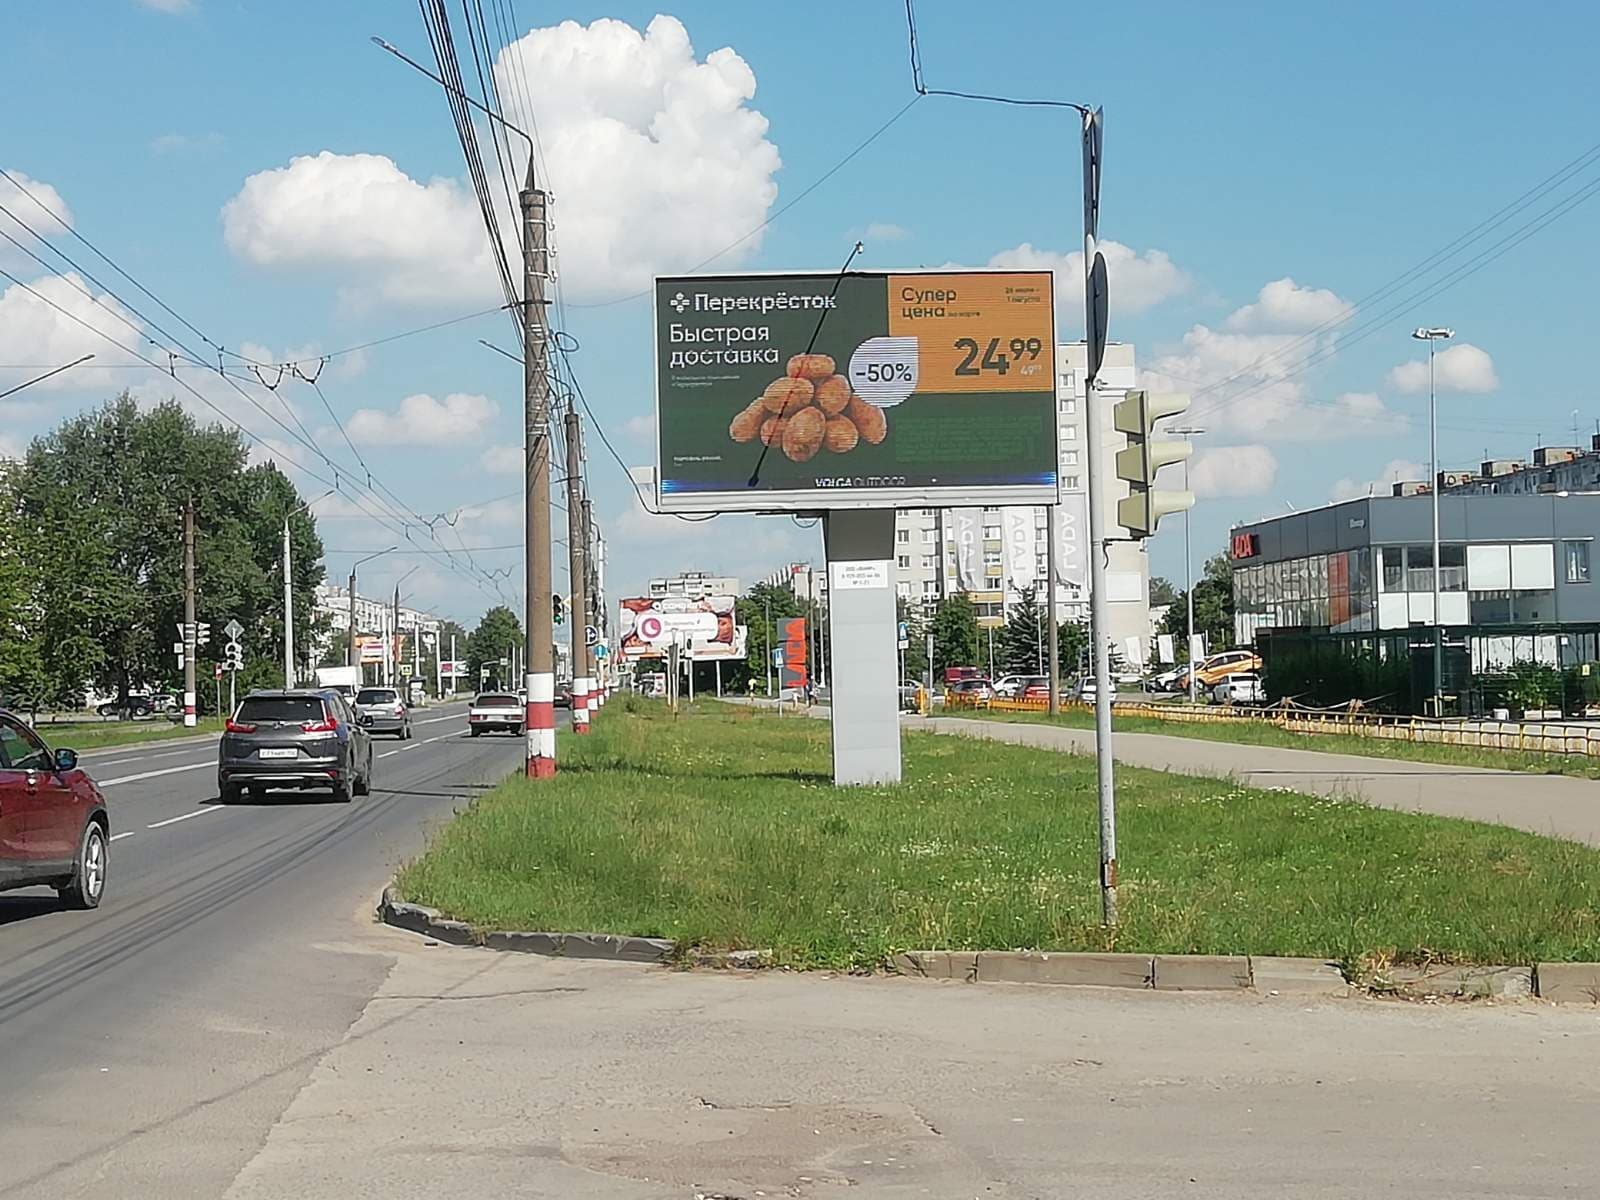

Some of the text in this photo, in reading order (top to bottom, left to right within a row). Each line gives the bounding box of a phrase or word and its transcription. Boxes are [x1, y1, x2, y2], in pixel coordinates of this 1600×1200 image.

[695, 292, 837, 314] Перекрёсток
[902, 287, 957, 304] Супер
[902, 305, 945, 320] цена
[670, 324, 769, 346] Быстрая
[670, 348, 779, 369] доставка
[856, 363, 912, 382] -50%
